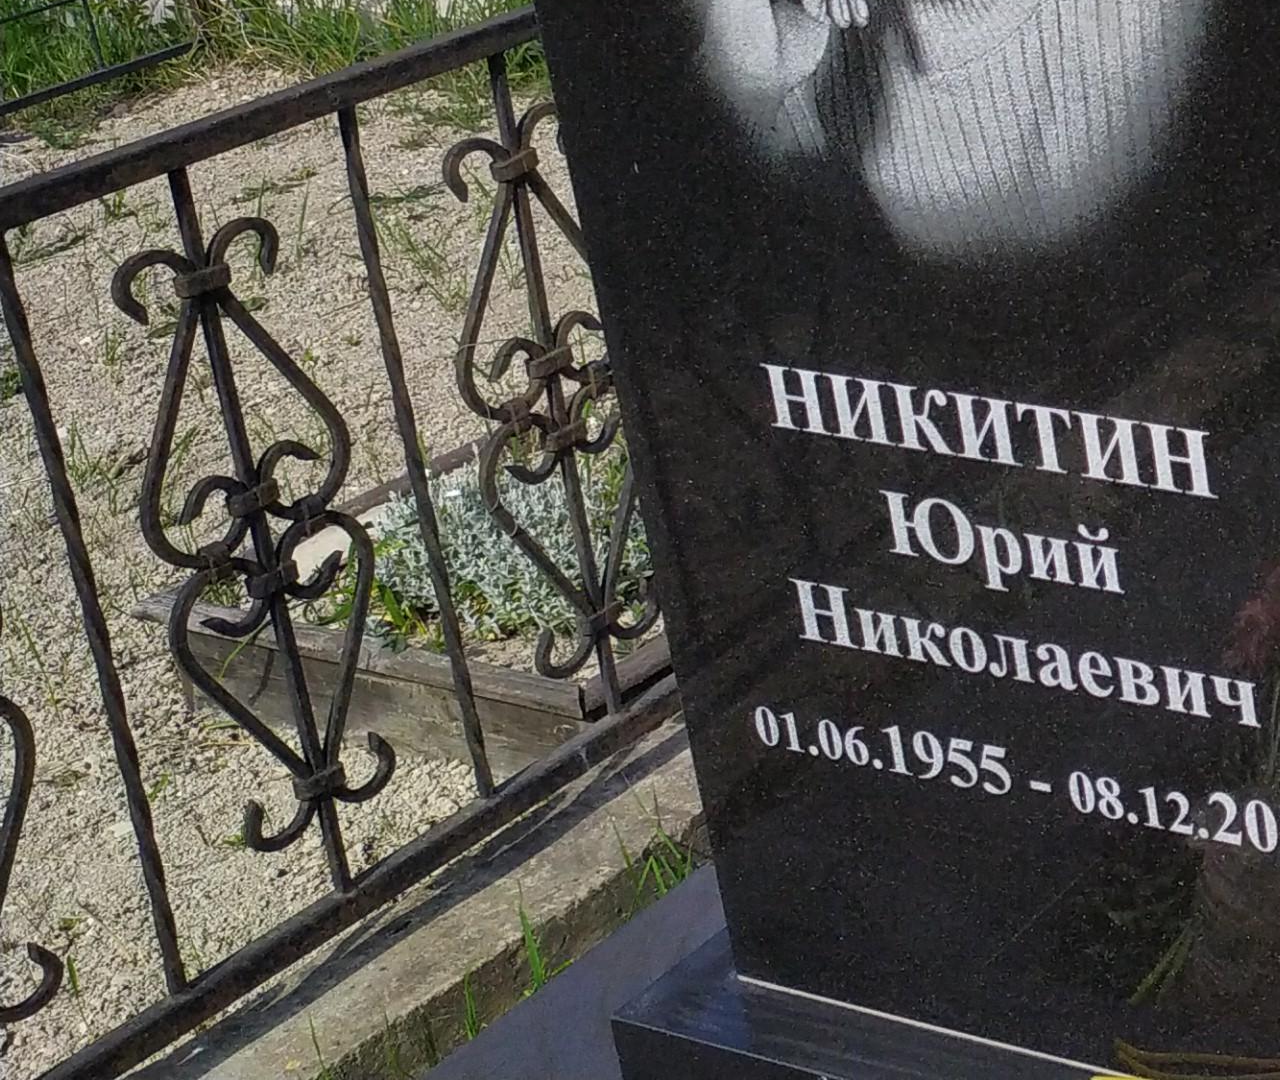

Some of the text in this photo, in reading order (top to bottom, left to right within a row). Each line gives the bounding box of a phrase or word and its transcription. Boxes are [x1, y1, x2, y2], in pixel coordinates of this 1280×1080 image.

[759, 363, 1218, 499] НИКИТИН
[879, 489, 1125, 594] Юрий
[789, 578, 1261, 728] Николаевич
[754, 706, 1012, 795] 01.06.1955
